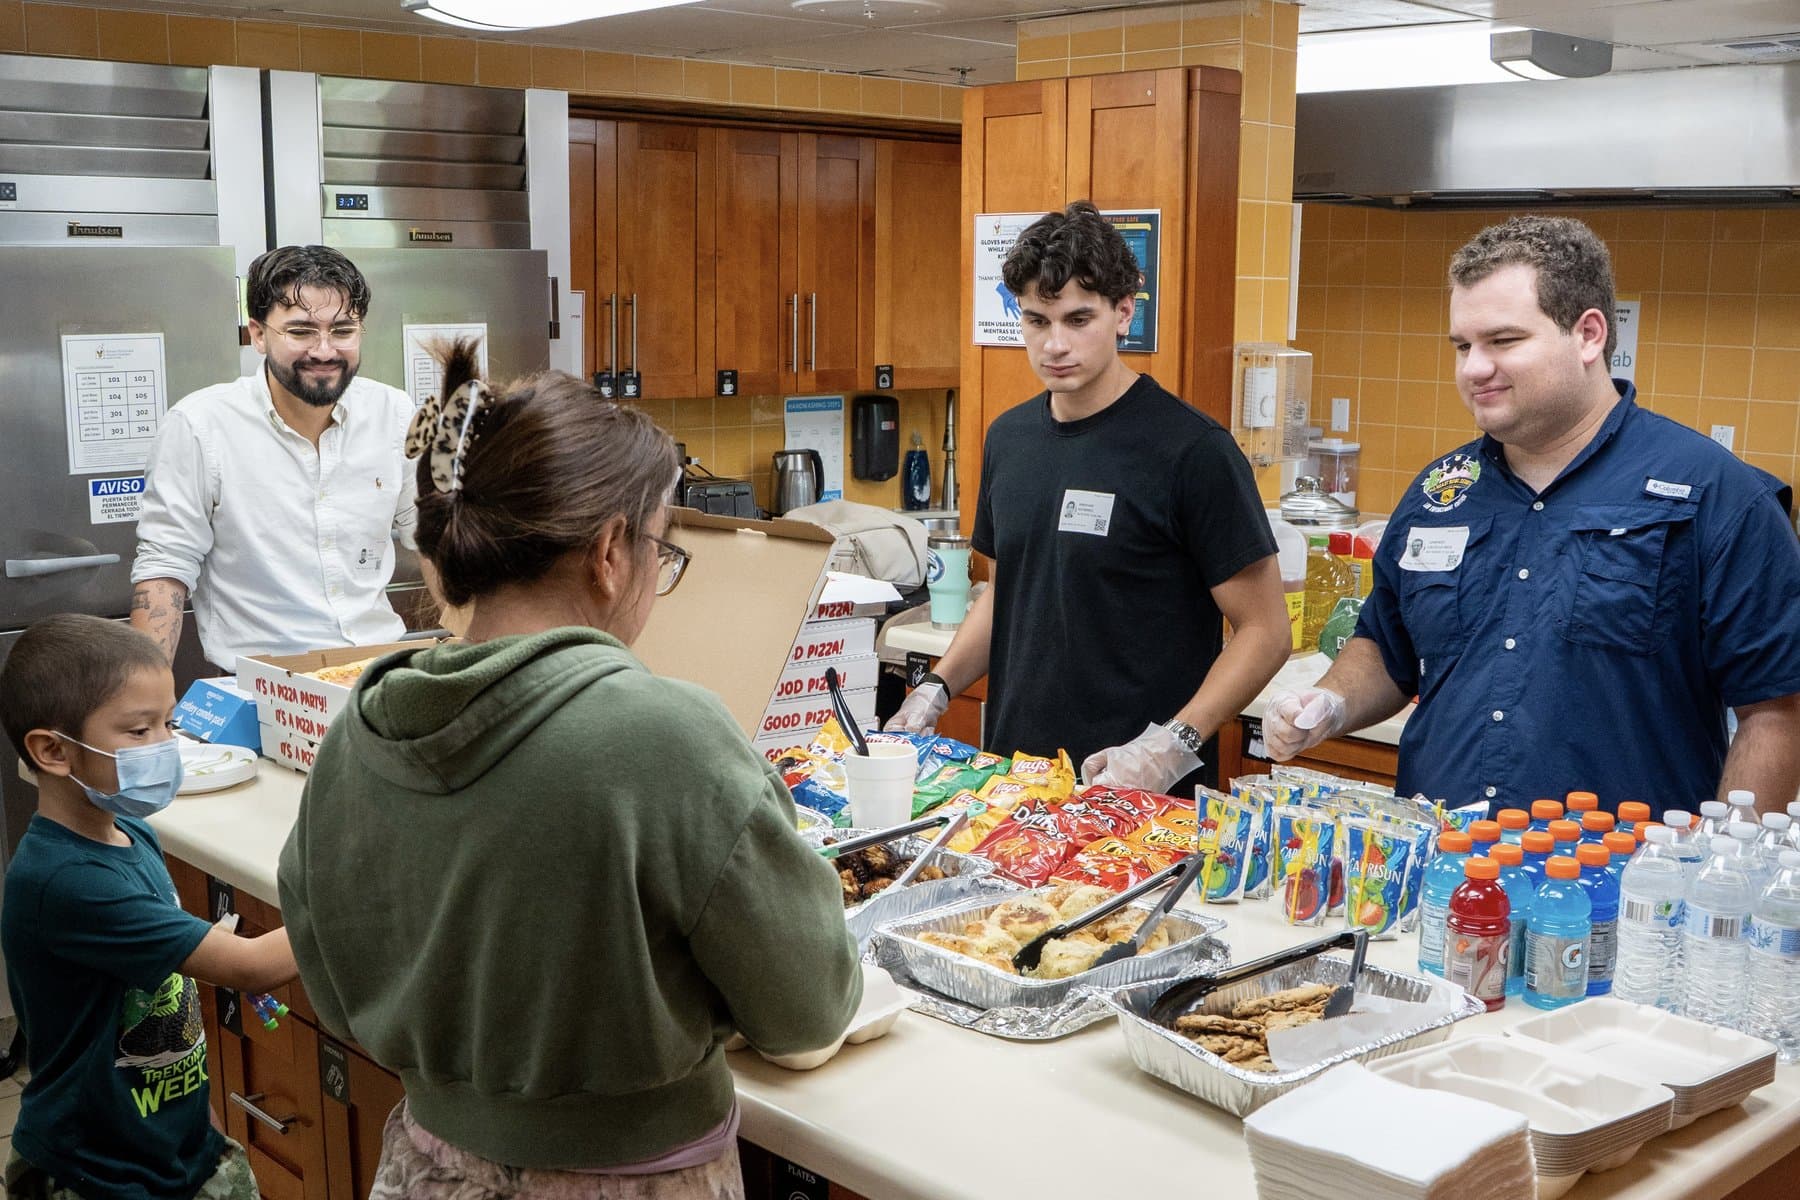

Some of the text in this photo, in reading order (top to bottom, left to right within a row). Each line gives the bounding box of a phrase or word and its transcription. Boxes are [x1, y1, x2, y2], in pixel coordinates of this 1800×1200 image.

[134, 375, 147, 383] 103
[135, 392, 148, 400] 105
[110, 409, 149, 418] 301 302
[98, 479, 141, 494] AVISO
[101, 506, 125, 514] CERRADA
[818, 601, 854, 618] PIZZA!
[807, 638, 844, 659] PIZZA!
[255, 676, 327, 713] IT'S A PIZZA PARTY!
[275, 708, 287, 726] IT'S
[295, 715, 316, 736] PIZZA
[763, 712, 801, 731] GOOD
[280, 741, 292, 759] IT'S
[1013, 759, 1050, 773] Lay's
